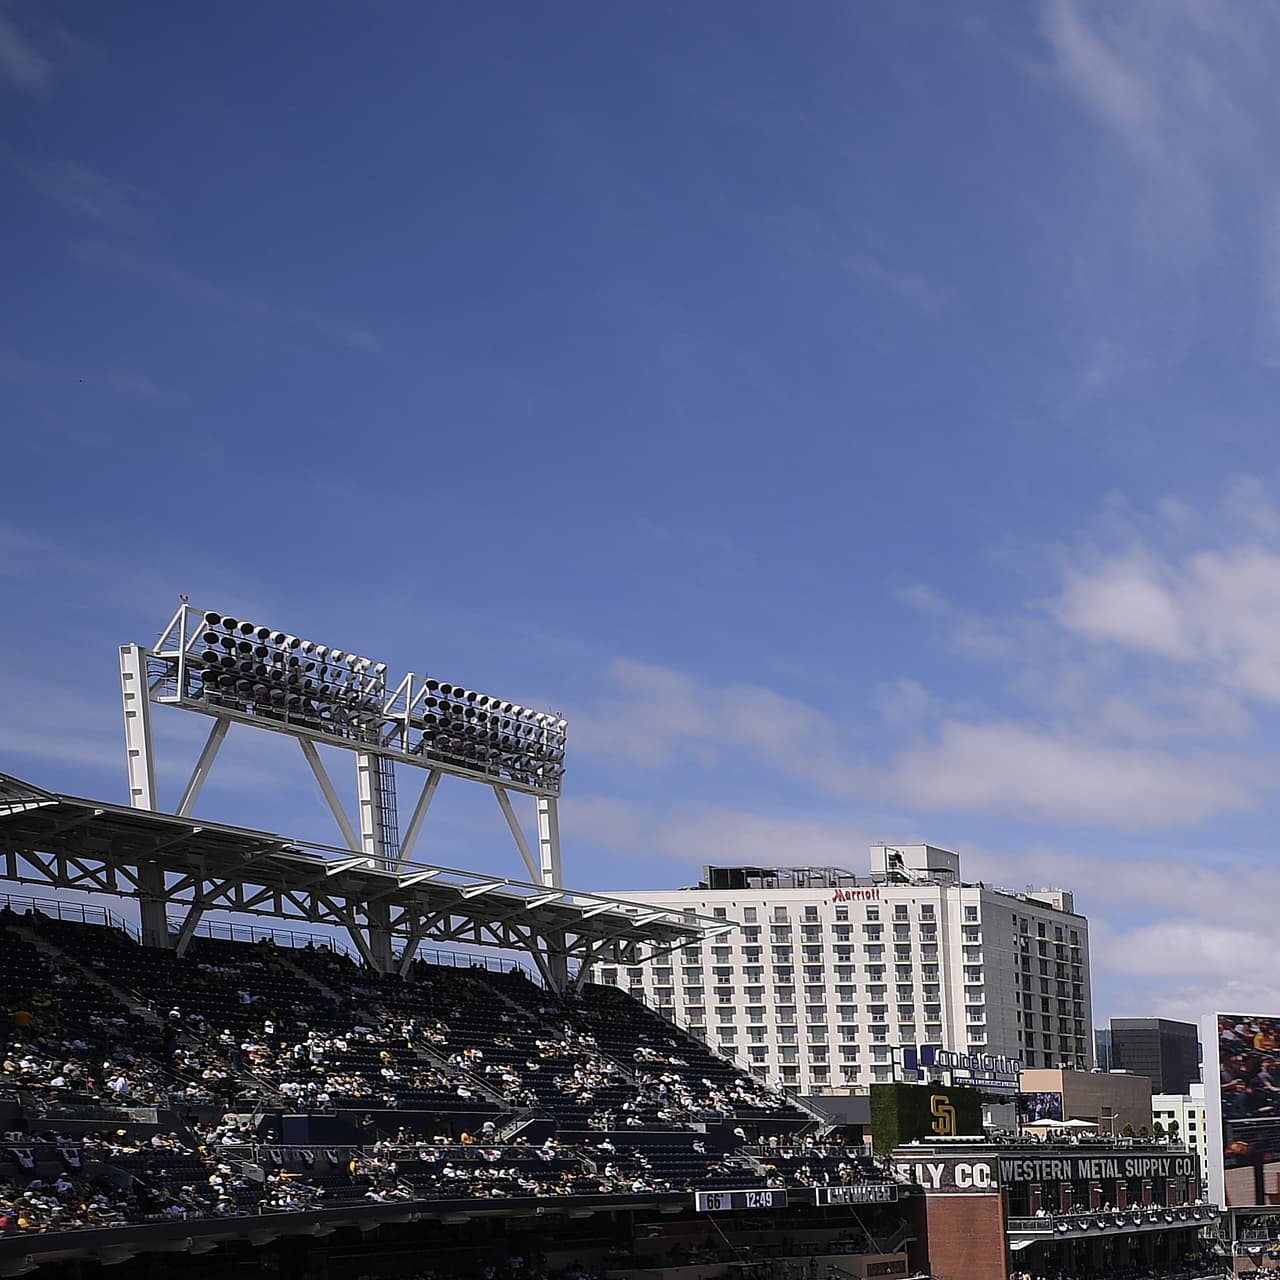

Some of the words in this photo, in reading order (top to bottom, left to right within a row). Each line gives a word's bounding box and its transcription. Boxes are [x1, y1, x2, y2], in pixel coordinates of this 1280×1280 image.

[832, 889, 880, 902] Marriott
[954, 1163, 998, 1189] CO.
[1001, 1159, 1071, 1182] WESTERN
[1078, 1159, 1122, 1181] METAL
[1125, 1158, 1170, 1179] SUPPLY
[1175, 1158, 1194, 1177] CO.
[745, 1192, 773, 1208] 12:49
